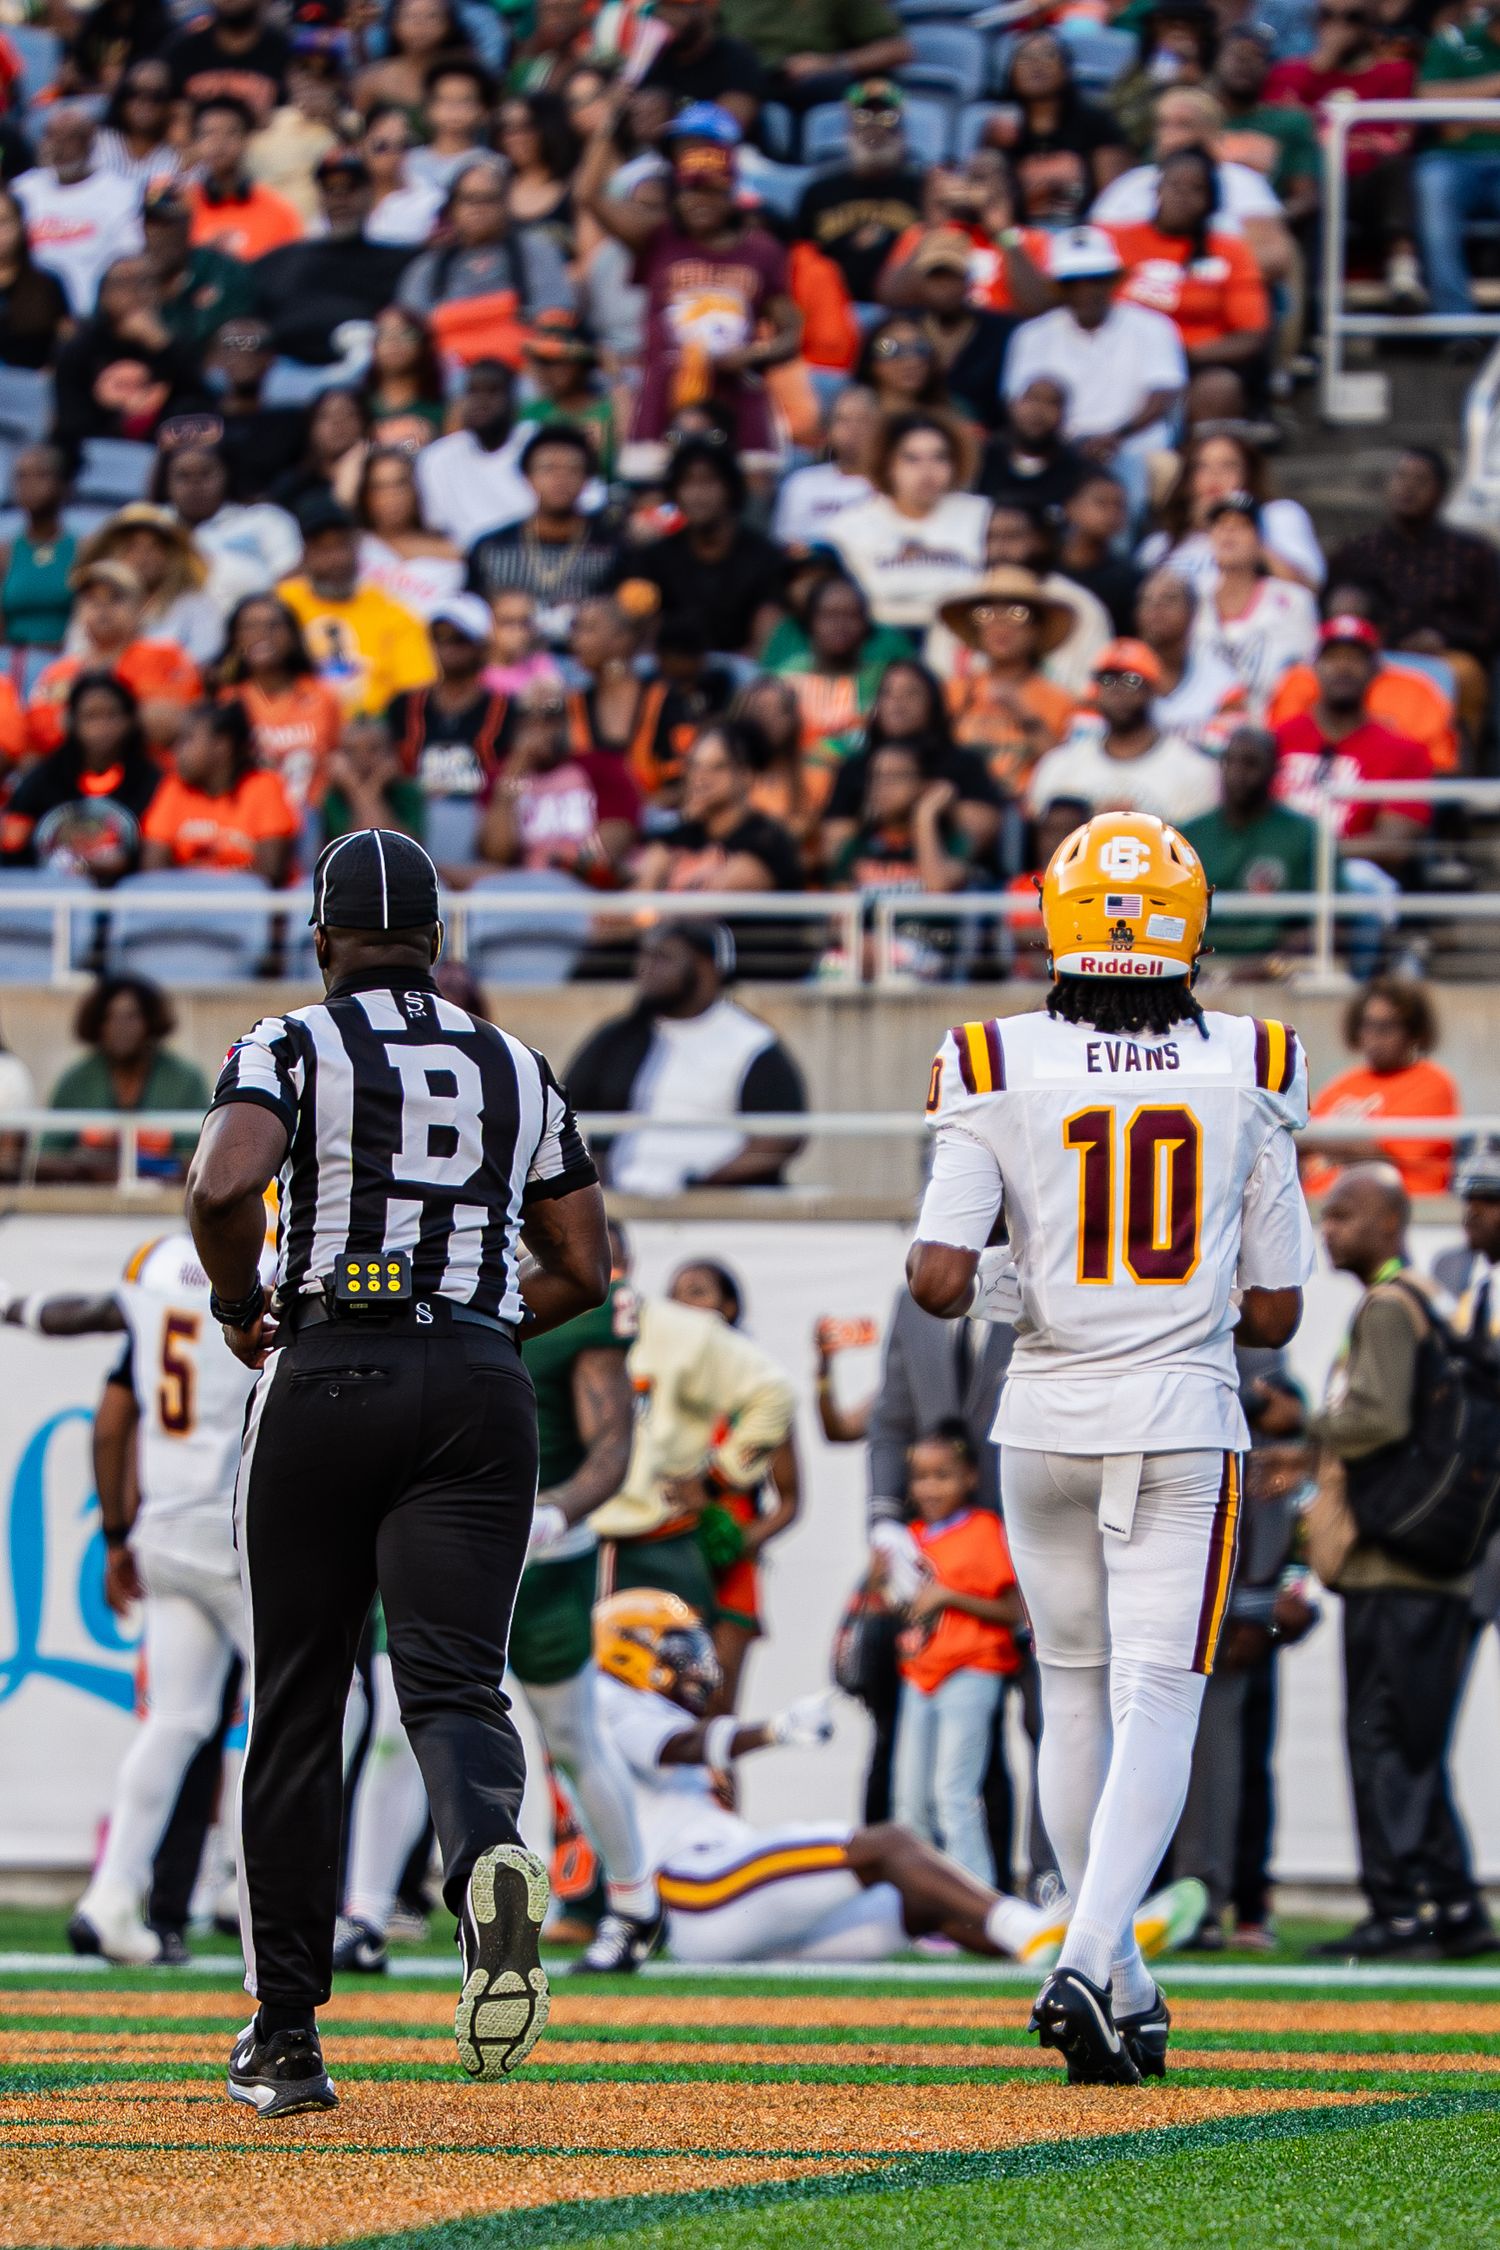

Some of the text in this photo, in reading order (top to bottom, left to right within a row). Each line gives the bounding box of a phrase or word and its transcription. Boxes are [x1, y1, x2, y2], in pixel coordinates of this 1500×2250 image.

[1080, 956, 1163, 976] Riddell
[1086, 1041, 1180, 1073] EVANS
[383, 1043, 485, 1186] B
[1062, 1103, 1203, 1286] 10
[416, 1302, 434, 1323] S
[158, 1307, 202, 1438] 5
